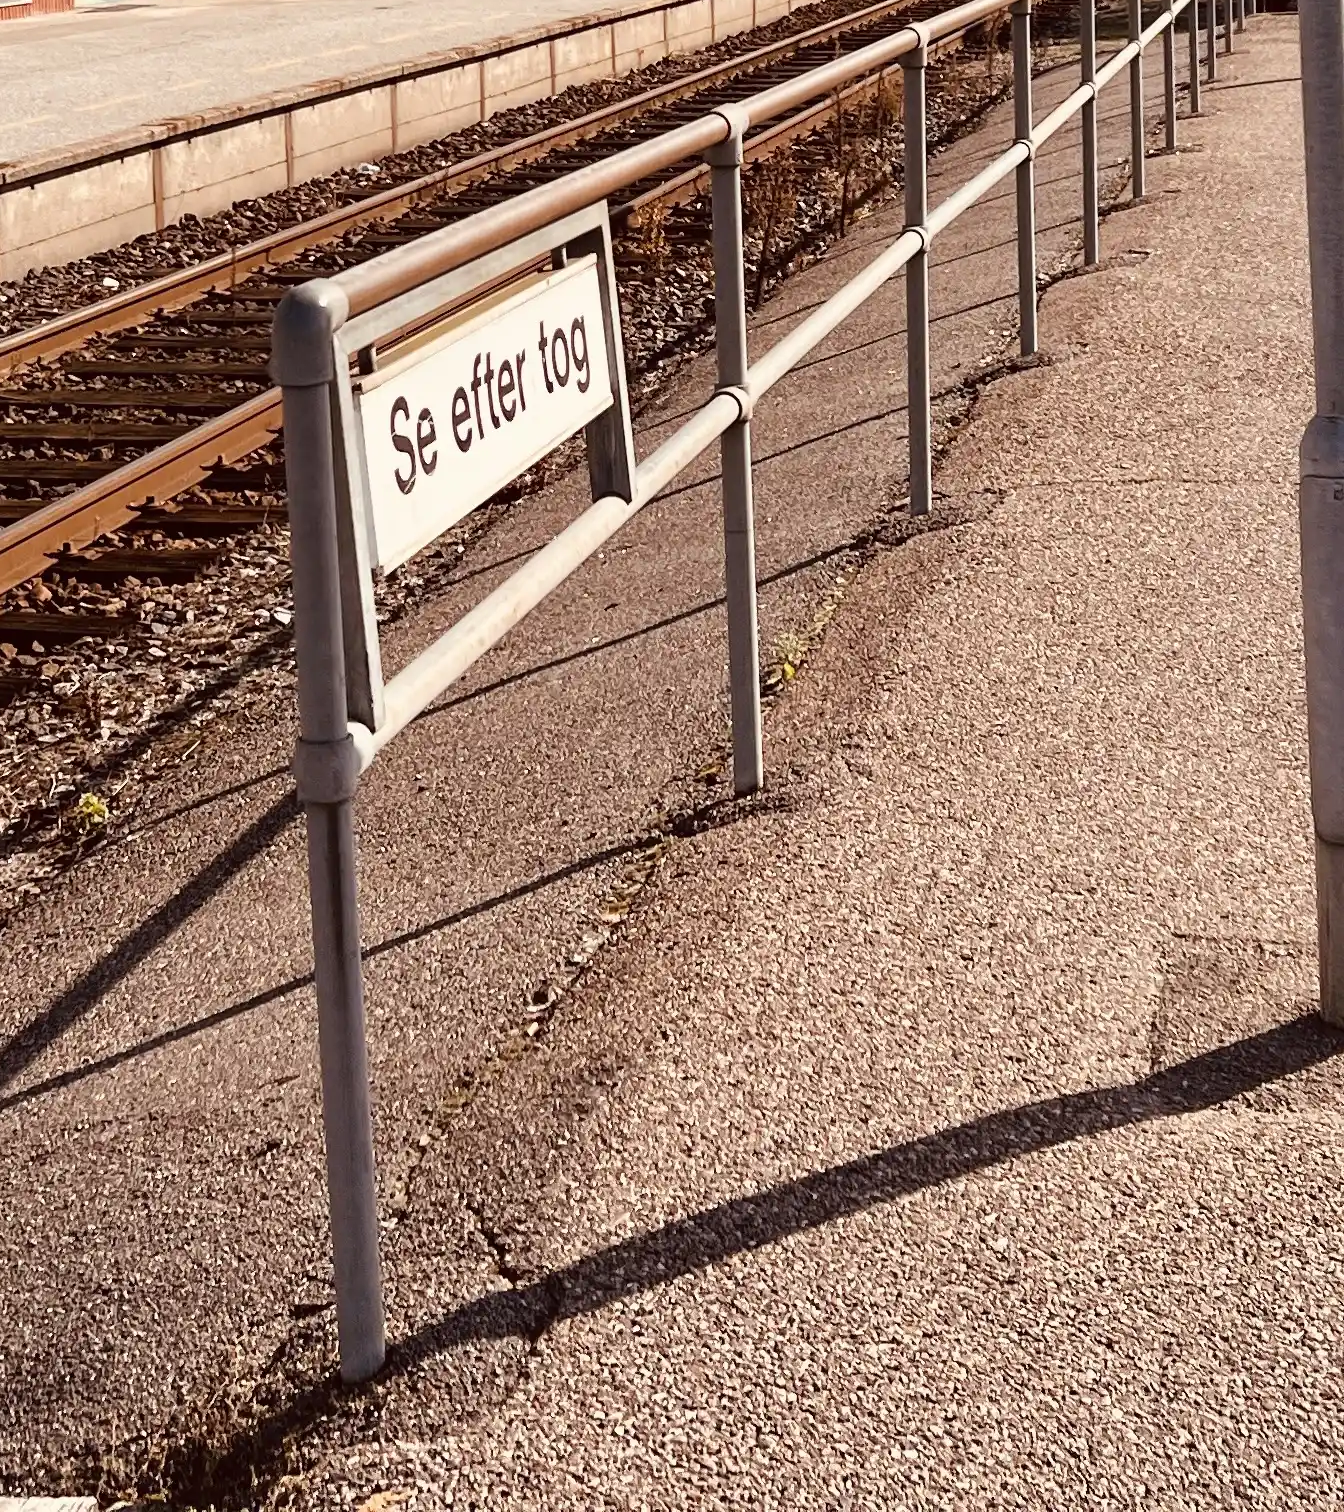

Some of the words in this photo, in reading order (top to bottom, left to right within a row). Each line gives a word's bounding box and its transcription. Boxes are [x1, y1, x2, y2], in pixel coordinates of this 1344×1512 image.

[389, 395, 438, 496] Se
[451, 347, 526, 453] efter
[537, 314, 592, 394] tog
